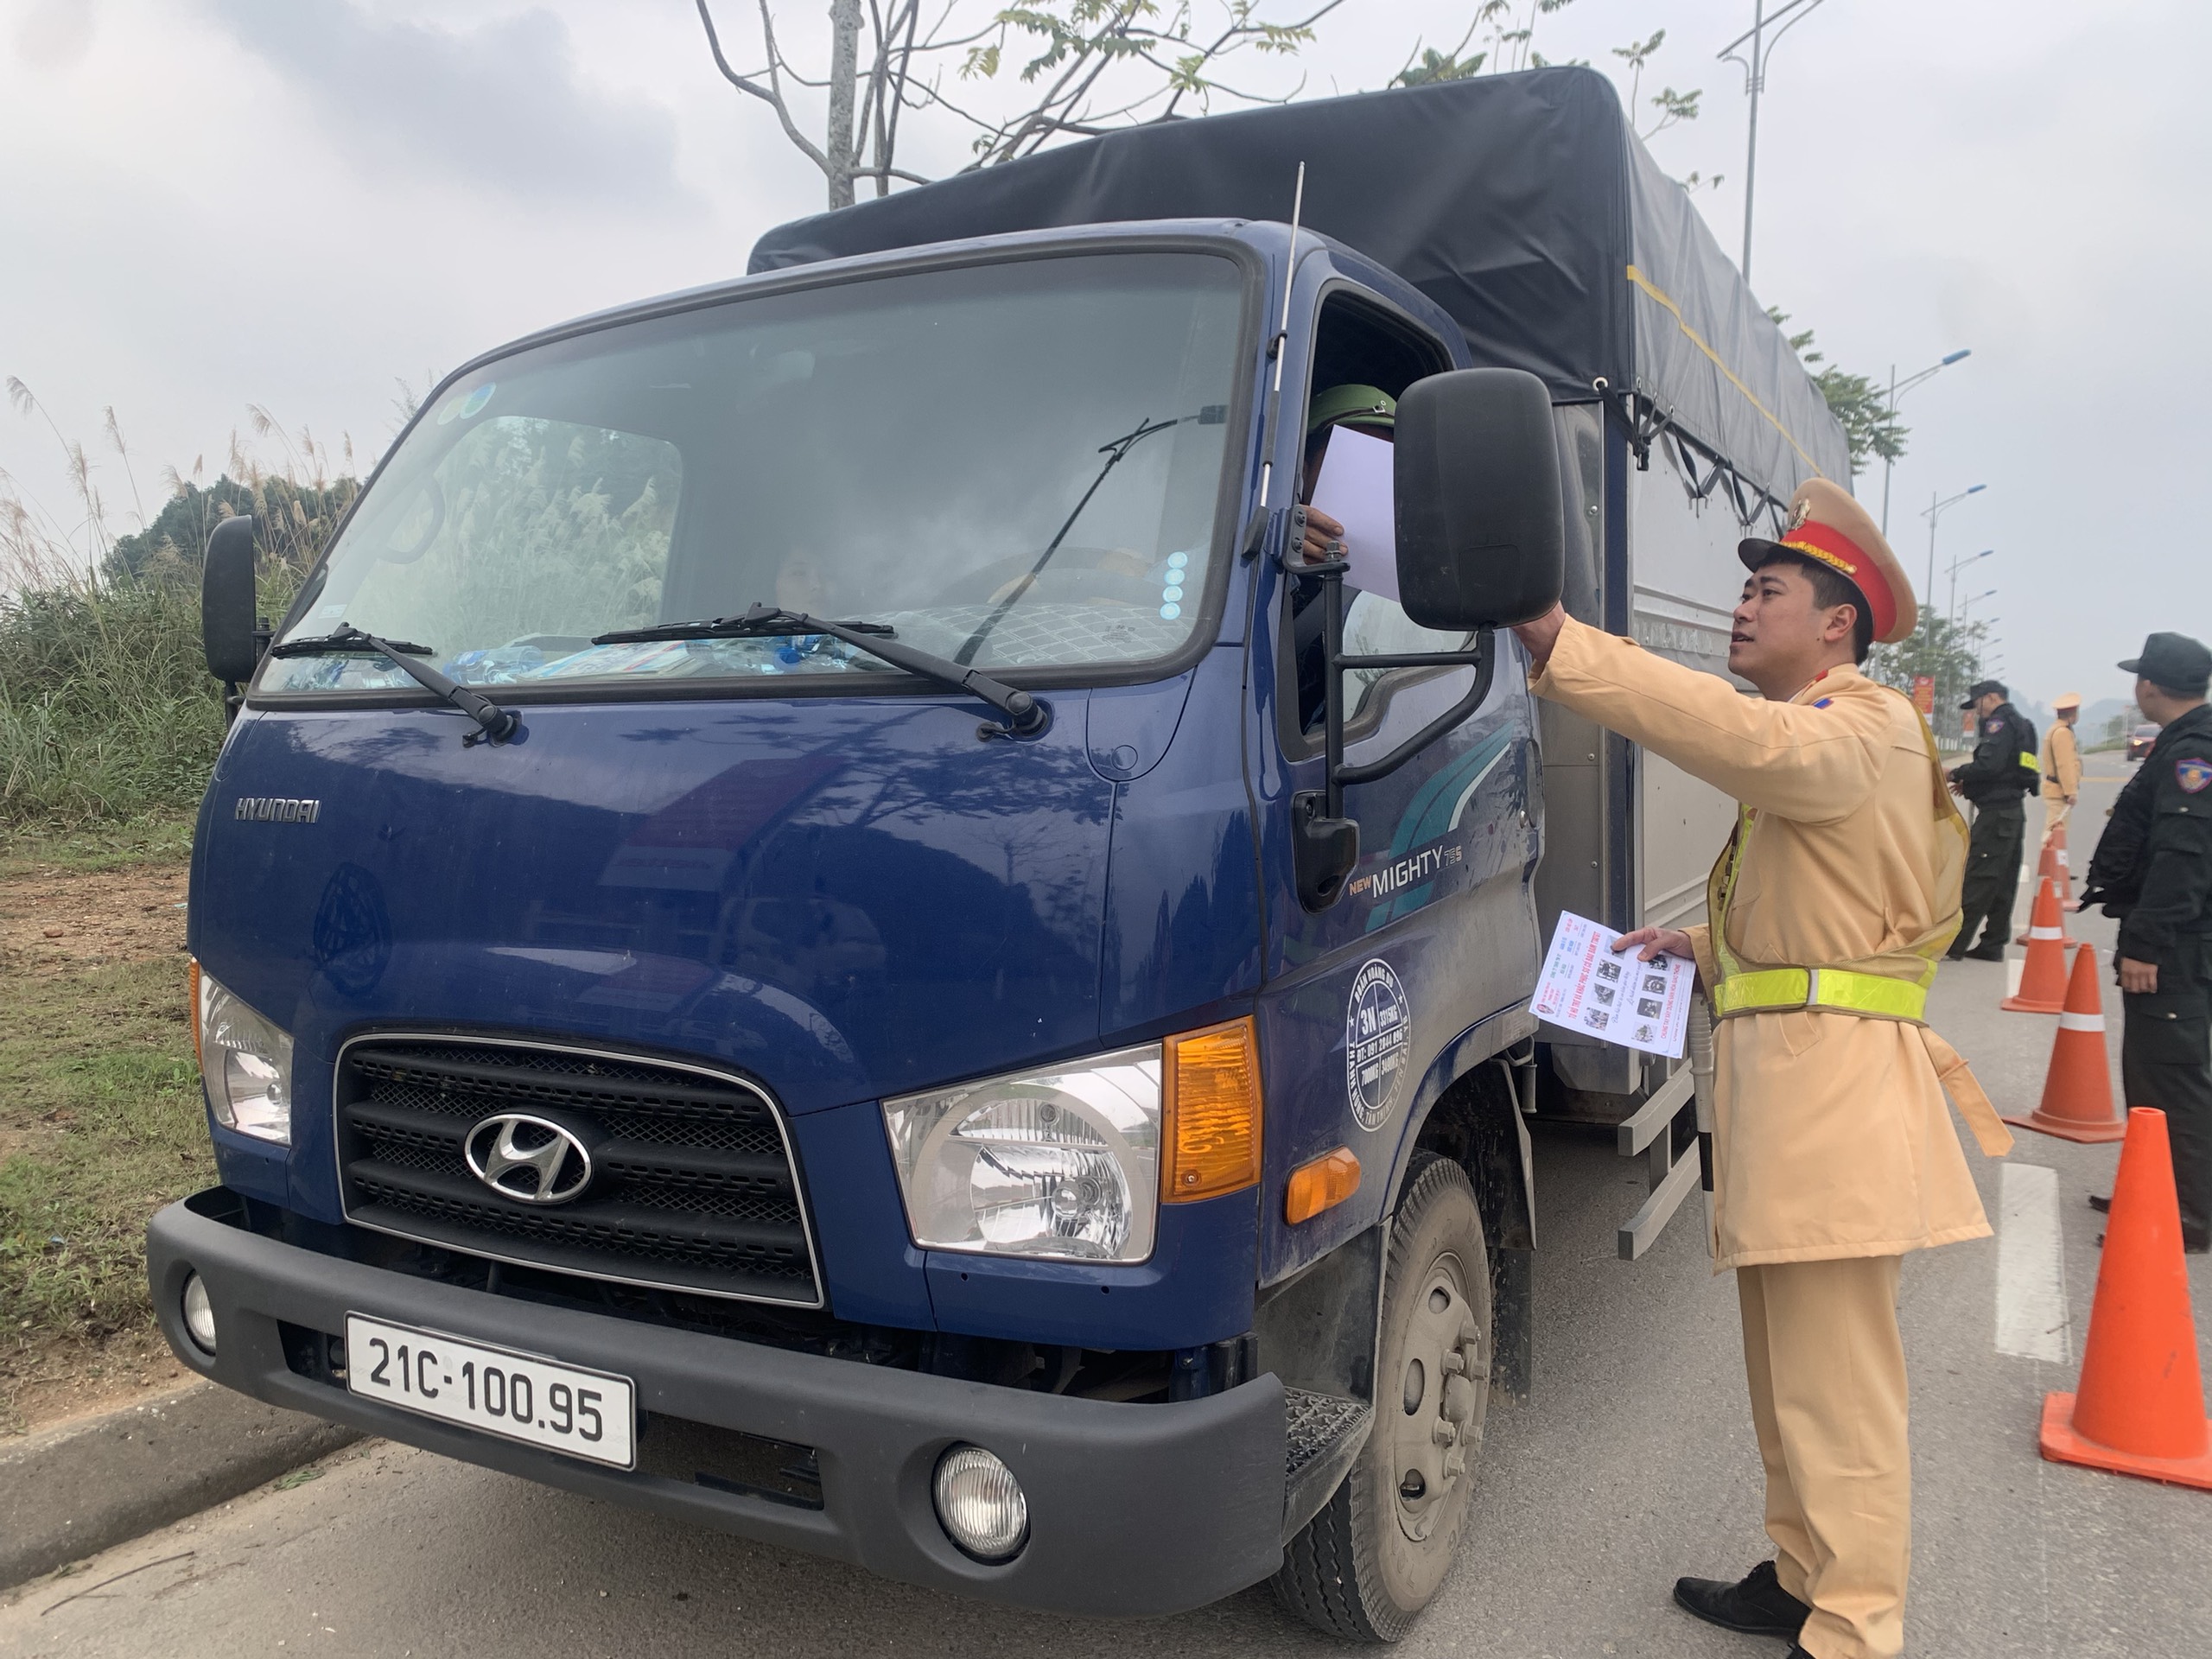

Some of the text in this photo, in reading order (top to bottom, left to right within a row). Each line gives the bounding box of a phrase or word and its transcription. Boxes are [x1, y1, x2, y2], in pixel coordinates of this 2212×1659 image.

[234, 798, 322, 823] HYUNDAI
[1349, 875, 1371, 896] NEW
[1372, 845, 1443, 899] MIGHTY
[1361, 1007, 1376, 1035] 3N
[369, 1337, 604, 1443] 21C-100.95
